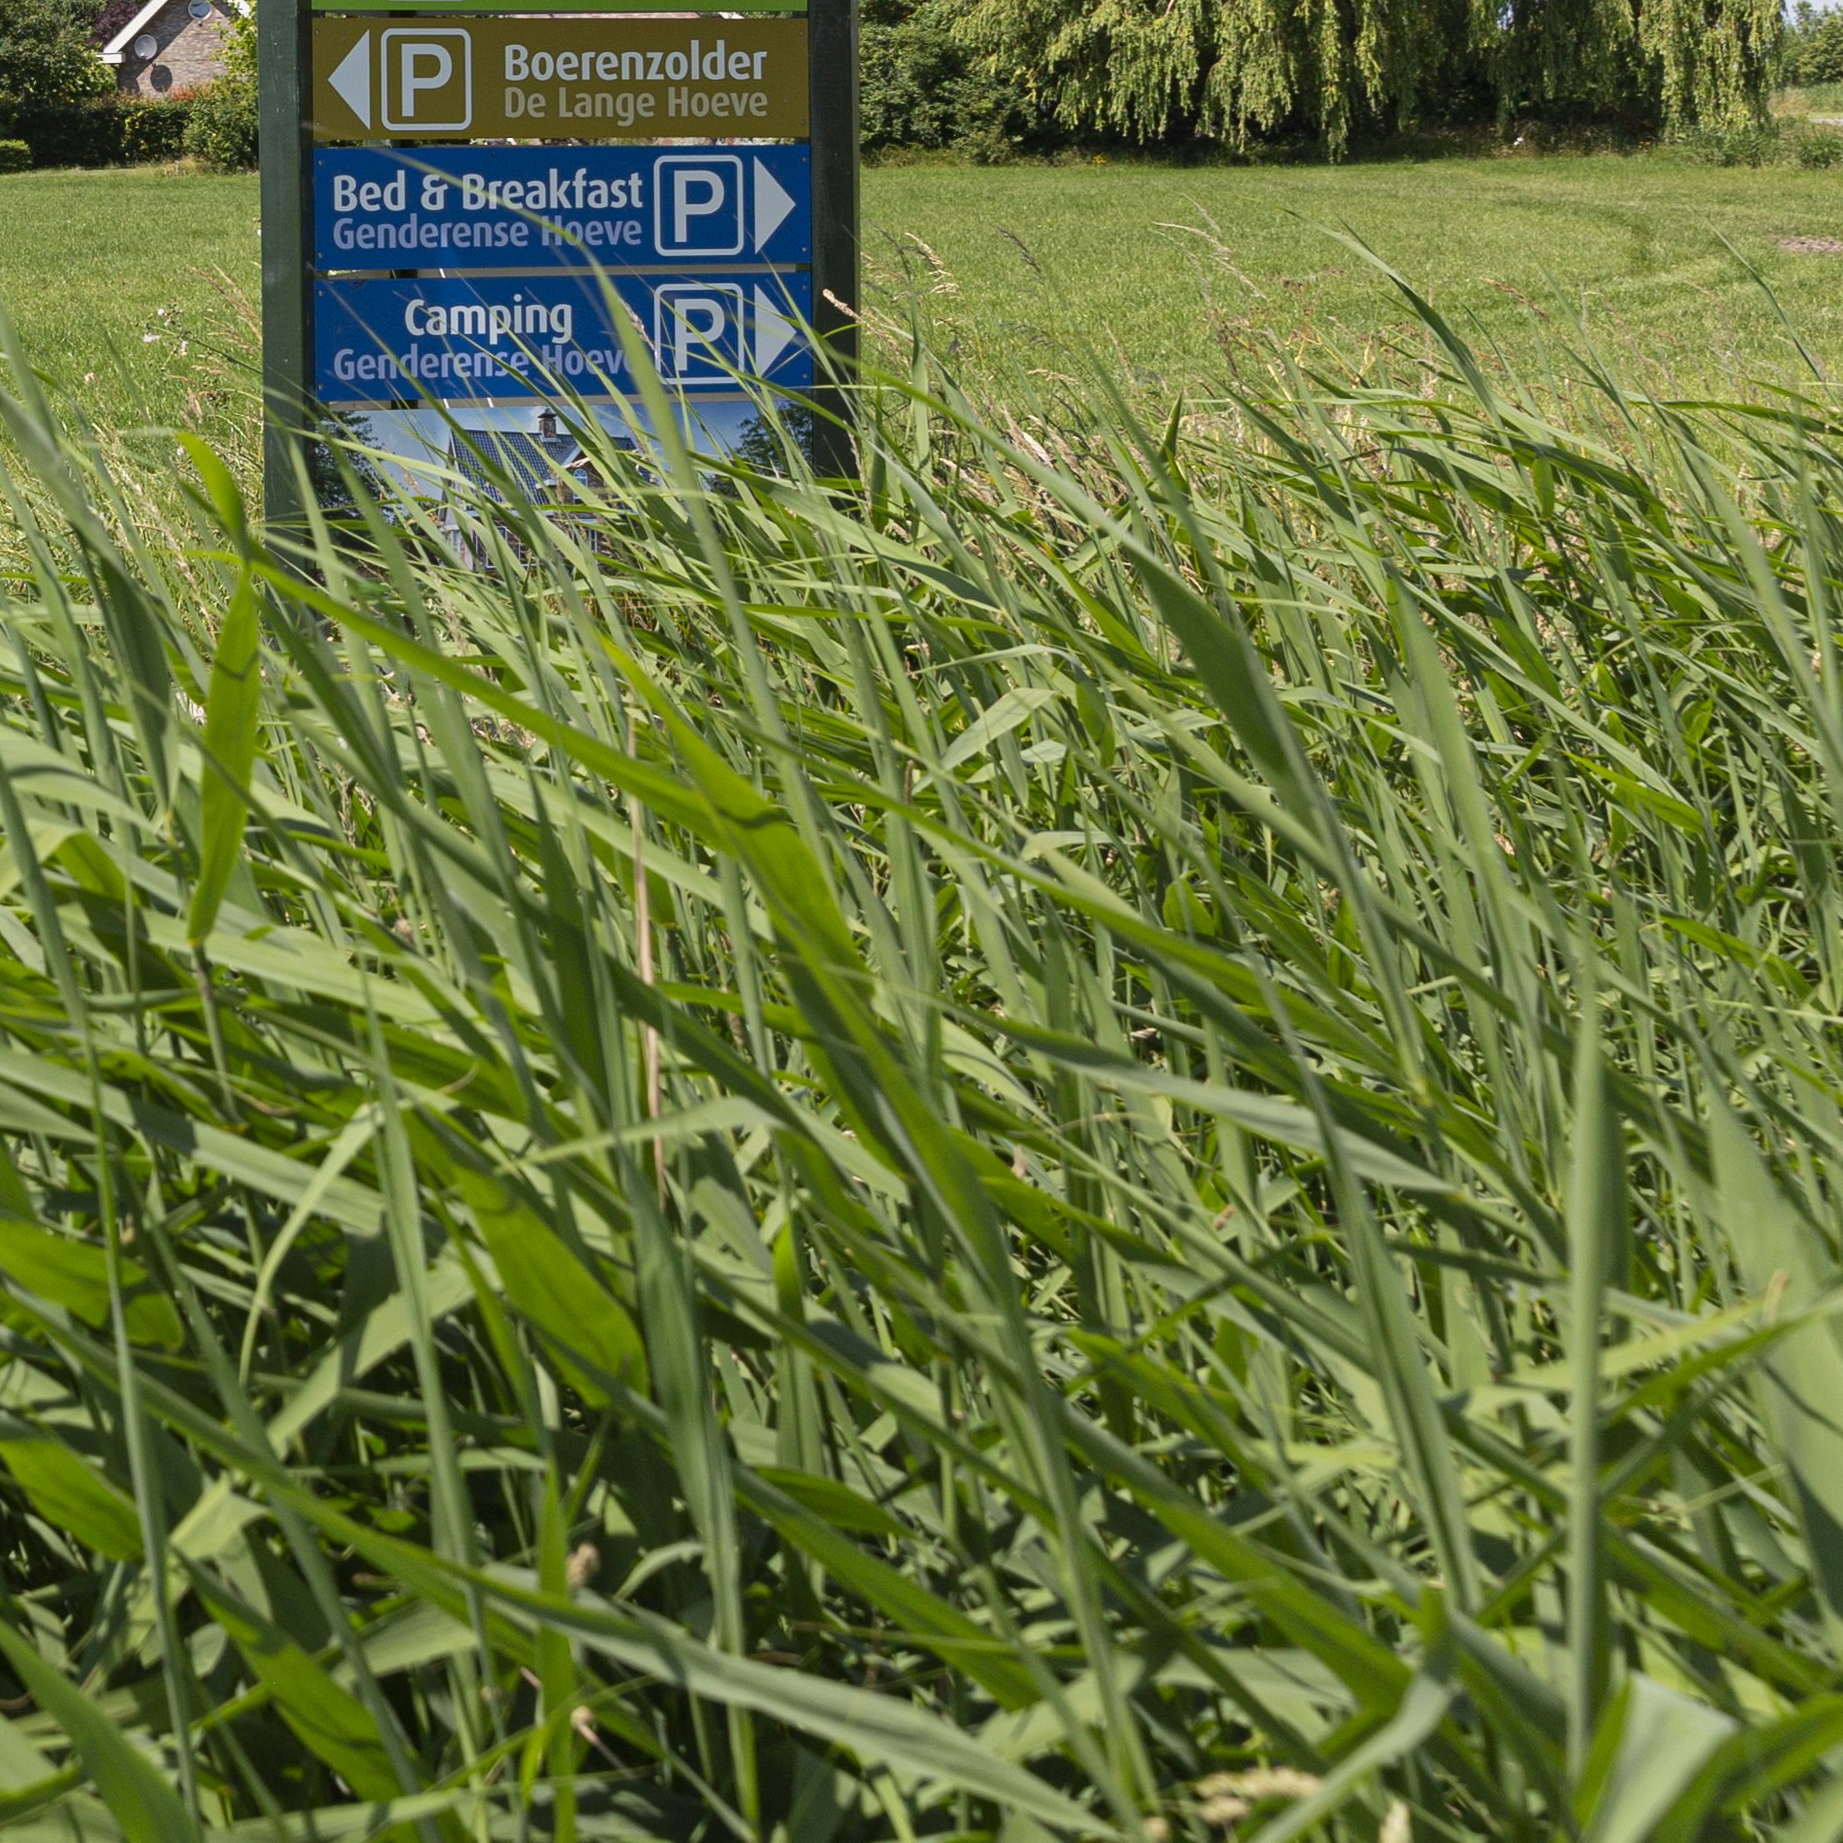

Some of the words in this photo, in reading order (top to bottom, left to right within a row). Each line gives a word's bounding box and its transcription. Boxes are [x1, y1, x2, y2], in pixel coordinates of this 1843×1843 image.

[401, 43, 452, 116] P
[505, 40, 767, 81] Boerenzolder
[505, 87, 546, 118] De
[558, 88, 655, 126] Lange
[668, 88, 768, 118] Hoeve
[333, 170, 405, 212] Bed
[420, 174, 447, 211] &
[463, 168, 643, 210] Breakfast
[674, 171, 725, 242] P
[333, 213, 528, 248] Genderense
[542, 216, 642, 246] Hoeve
[405, 294, 571, 343] Camping
[674, 298, 725, 371] P
[335, 343, 528, 381] Genderense
